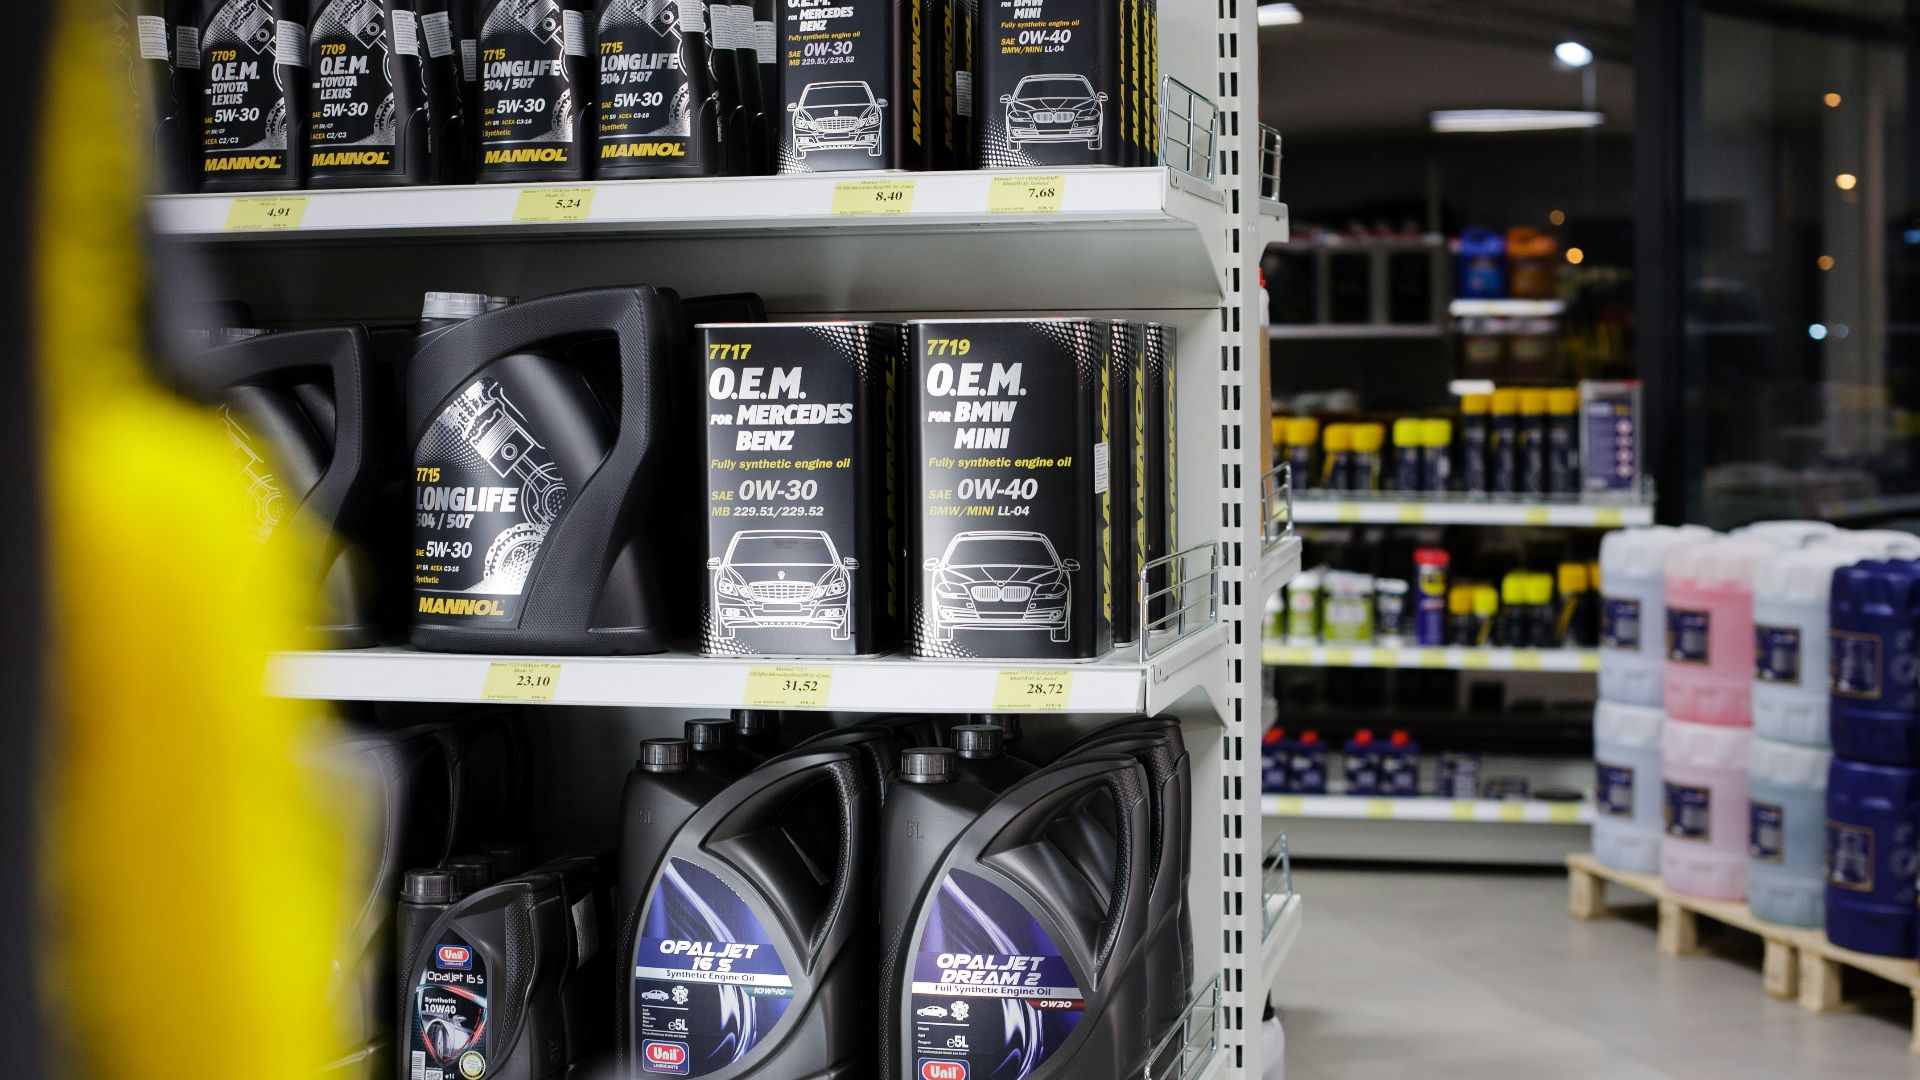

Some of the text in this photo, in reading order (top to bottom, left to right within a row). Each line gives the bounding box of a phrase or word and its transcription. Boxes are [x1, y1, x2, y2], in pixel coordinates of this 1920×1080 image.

[799, 6, 854, 20] MERCEDES
[1014, 8, 1041, 19] MINI
[799, 20, 827, 32] BENZ
[1017, 20, 1047, 29] synthetic
[1048, 20, 1070, 28] engine
[788, 34, 801, 42] Fully
[803, 33, 830, 41] synthetic
[831, 31, 851, 40] engine
[1018, 29, 1072, 45] 0W-40
[320, 44, 346, 56] 7709
[600, 41, 623, 54] 7715
[804, 41, 853, 57] 0W-30
[1001, 45, 1065, 54] BMW/MINI LL-04
[212, 50, 236, 62] 7709
[483, 49, 506, 61] 7715
[600, 52, 680, 72] LONGLIFE
[211, 61, 260, 81] O.E.M.
[320, 55, 369, 76] O.E.M.
[483, 60, 560, 79] LONGLIFE
[320, 76, 357, 88] TOYOTA
[483, 79, 503, 91] 504
[512, 77, 535, 89] 507
[600, 73, 620, 85] 504
[629, 71, 652, 83] 507
[212, 81, 248, 94] TOYOTA
[320, 88, 352, 100] LEXUS
[212, 94, 243, 105] LEXUS
[497, 98, 545, 113] 5W-30
[601, 92, 663, 109] SAE 5W-30
[215, 107, 260, 123] 5W-30
[322, 102, 368, 118] 5W-30
[484, 128, 511, 137] Synthetic
[601, 123, 628, 131] Synthetic
[484, 148, 568, 164] MANNOL
[601, 142, 685, 158] MANNOL
[205, 156, 281, 171] MANNOL
[311, 151, 389, 167] MANNOL
[876, 191, 903, 202] 8,40
[1028, 188, 1055, 198] 7,68
[555, 199, 581, 209] 5,24
[708, 344, 752, 360] 7717
[926, 339, 971, 356] 7719
[708, 366, 807, 400] O.E.M.
[926, 362, 1027, 397] O.E.M.
[709, 403, 853, 425] FOR MERCEDES
[928, 400, 1017, 423] FOR BMW
[736, 430, 795, 451] BENZ
[954, 427, 1010, 449] MINI
[710, 457, 851, 471] Fully synthetic engine oil
[928, 456, 1072, 470] Fully synthetic engine oil
[416, 467, 440, 482] 7715
[711, 479, 818, 501] SAE 0W-30
[928, 478, 1038, 500] SAE 0W-40
[416, 486, 519, 513] LONGLIFE
[711, 506, 824, 518] MB 229.51/229.52
[928, 505, 1030, 517] BMW/MINI LL-04
[416, 513, 435, 528] 504
[446, 513, 475, 529] 507
[415, 541, 473, 559] SAE 5W-30
[415, 575, 439, 584] Synthetic
[418, 596, 505, 616] MANNOL
[516, 675, 551, 687] 23,10
[782, 680, 818, 692] 31,52
[1027, 683, 1063, 695] 28,72
[444, 949, 463, 960] Unil
[659, 940, 760, 959] OPALJET
[692, 956, 734, 972] 16 S
[936, 953, 1045, 971] OPALJET
[466, 974, 476, 984] 16
[477, 974, 484, 984] S
[666, 969, 755, 982] Synthetic Engine Oil
[940, 969, 1042, 986] DREAM 2
[753, 986, 787, 996] 10W40
[935, 984, 1051, 997] Full Synthetic Engine Oil
[425, 996, 456, 1005] Synthetic
[424, 1004, 456, 1015] 10W40
[653, 1046, 678, 1061] Unil
[930, 1065, 957, 1079] Unil
